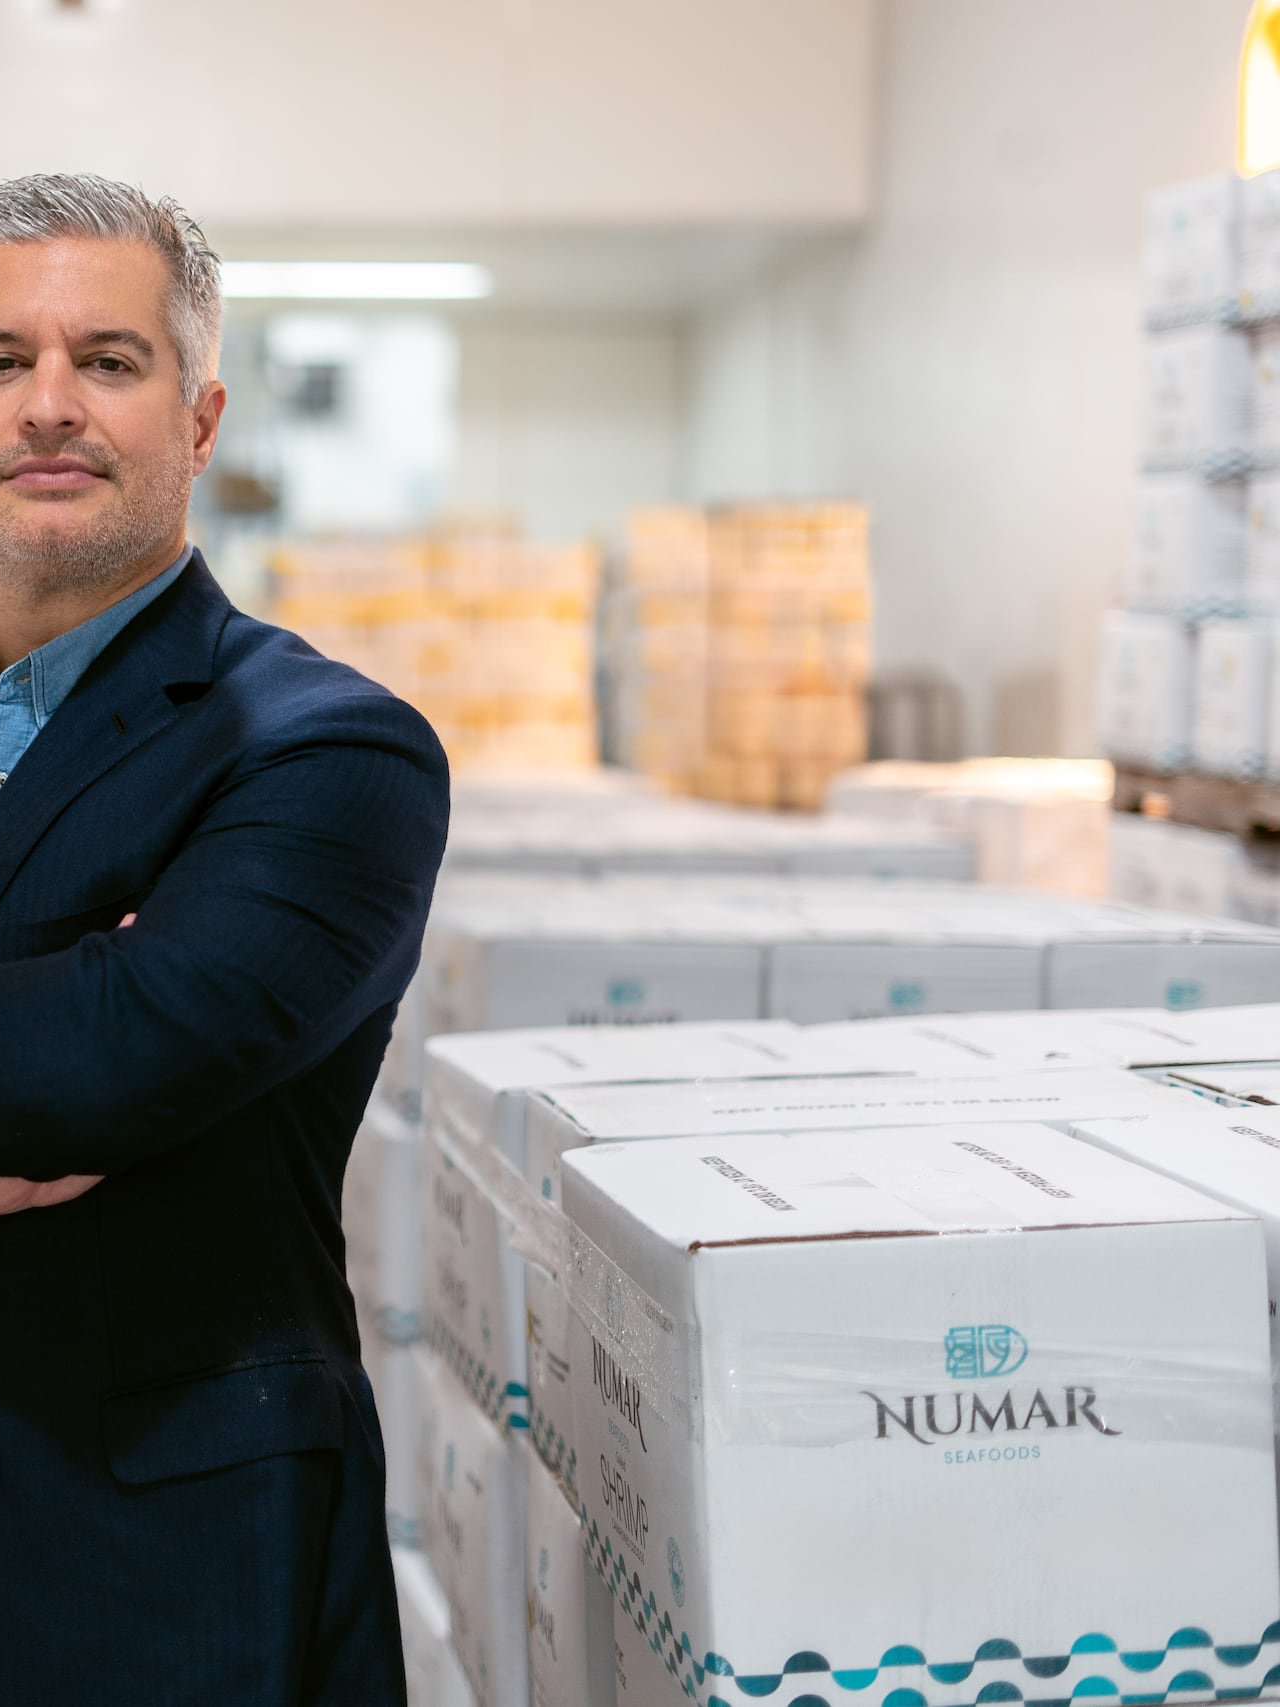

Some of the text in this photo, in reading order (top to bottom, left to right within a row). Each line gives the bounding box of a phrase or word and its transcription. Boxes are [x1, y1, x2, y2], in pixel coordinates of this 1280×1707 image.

[592, 1334, 648, 1453] NUMAR
[858, 1386, 1123, 1445] NUMAR
[943, 1446, 1041, 1464] SEAFOODS
[600, 1454, 649, 1550] SHRIMP
